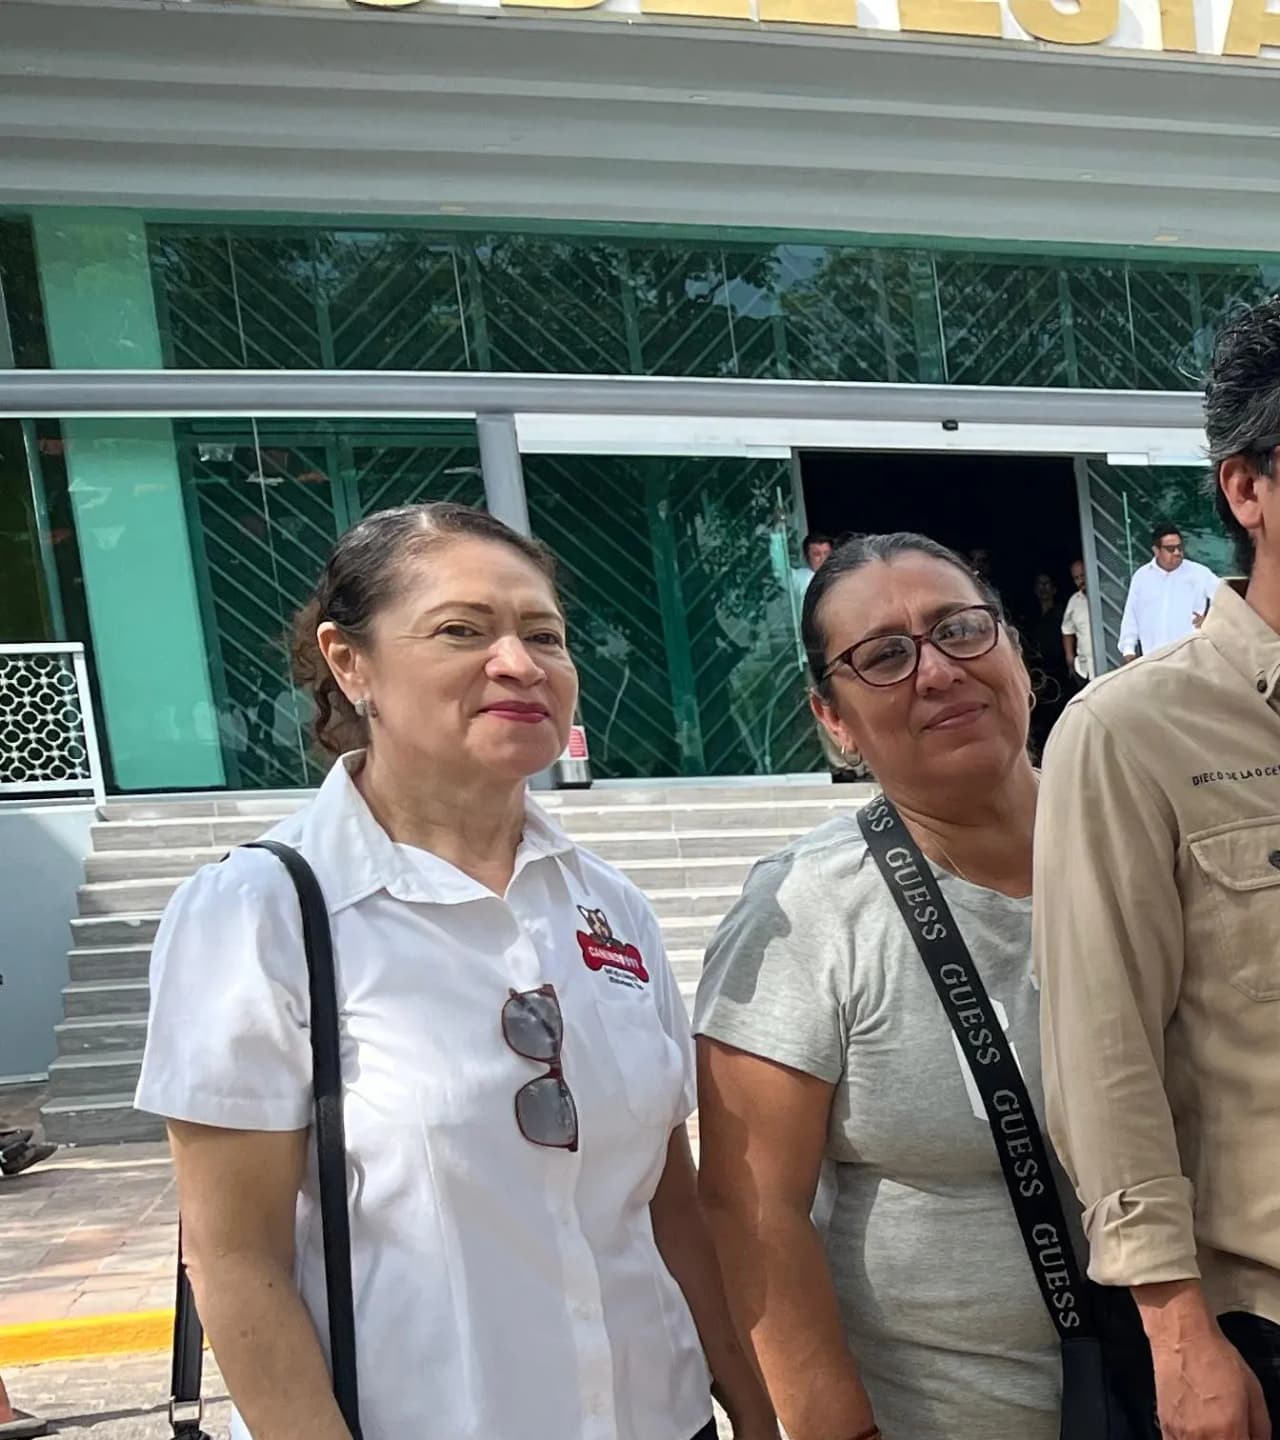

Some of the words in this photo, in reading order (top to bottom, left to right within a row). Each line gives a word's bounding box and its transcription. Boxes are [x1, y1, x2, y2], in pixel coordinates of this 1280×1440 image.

[885, 847, 947, 941] GUESS
[940, 963, 1001, 1065] GUESS
[993, 1089, 1045, 1198] GUESS
[1031, 1223, 1080, 1328] GUESS
